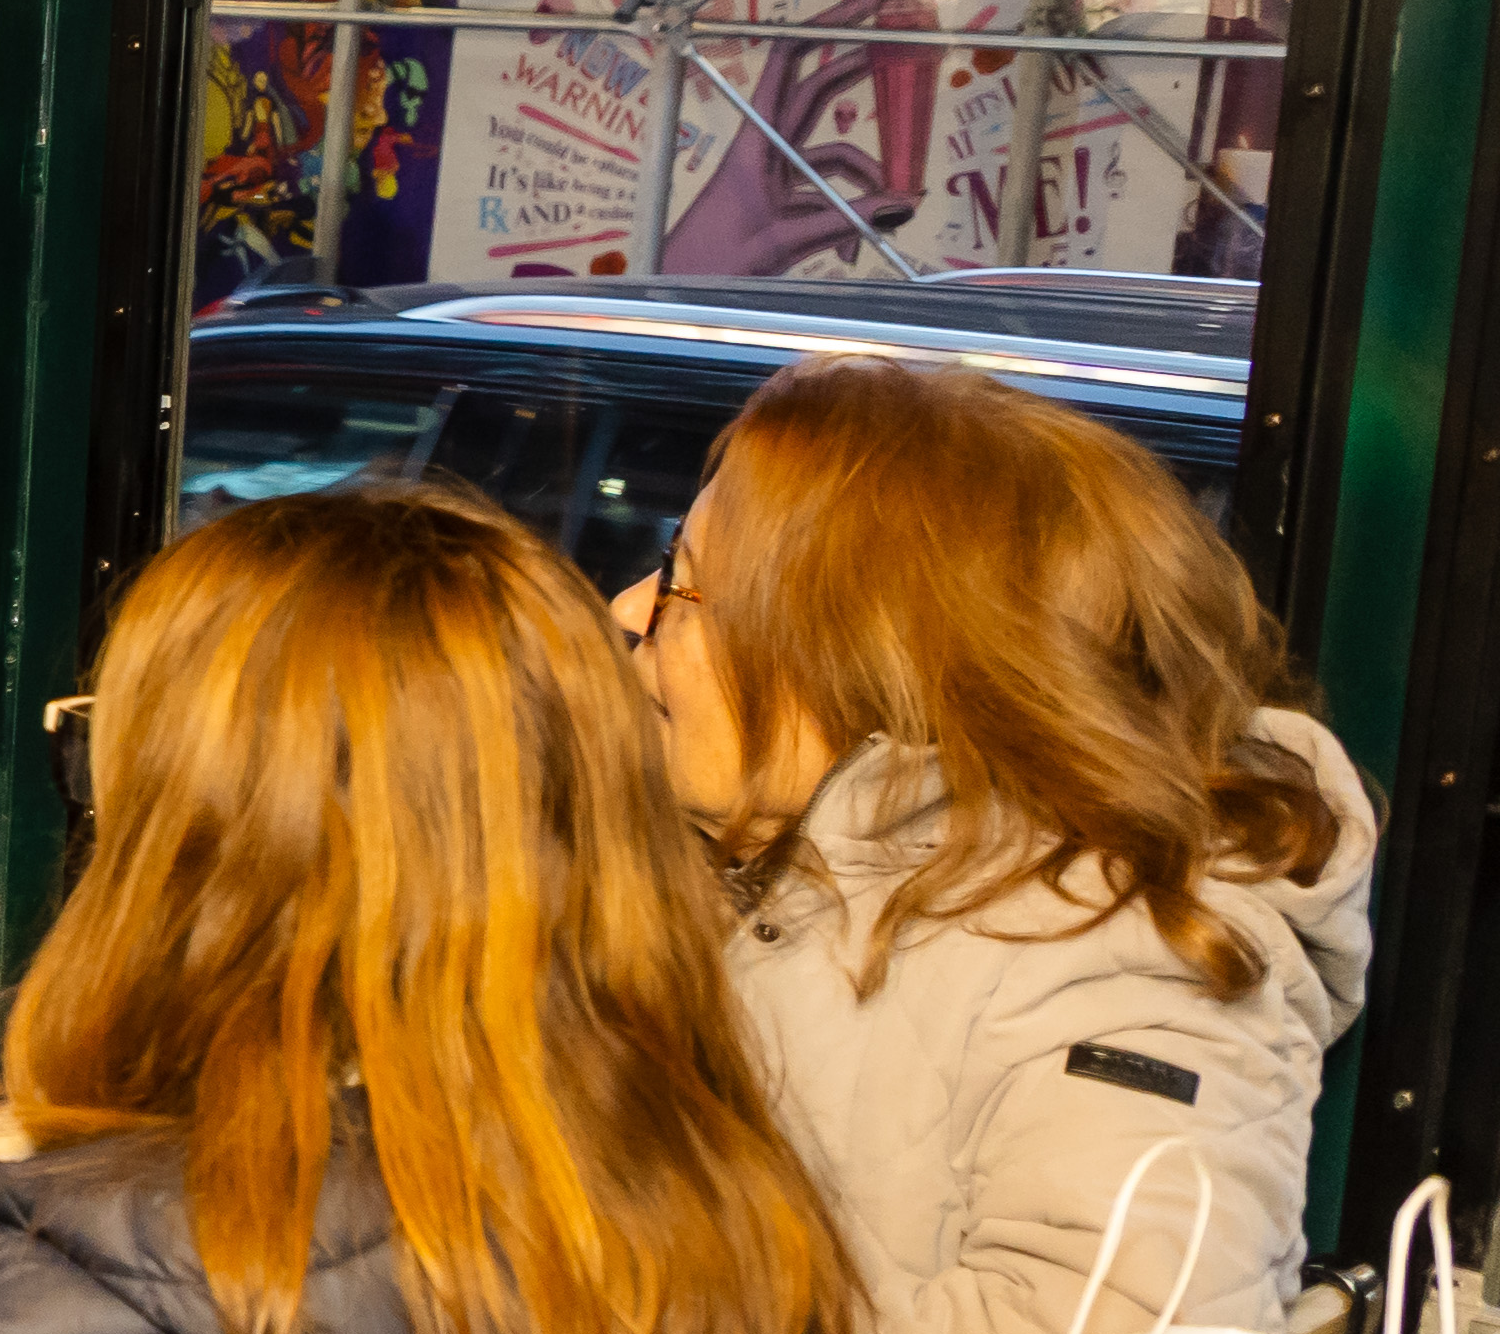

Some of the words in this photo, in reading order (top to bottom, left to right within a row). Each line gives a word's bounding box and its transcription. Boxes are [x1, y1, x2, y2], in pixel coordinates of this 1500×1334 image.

[516, 53, 646, 142] WARNIN
[486, 164, 528, 192] It's
[517, 204, 571, 226] AND
